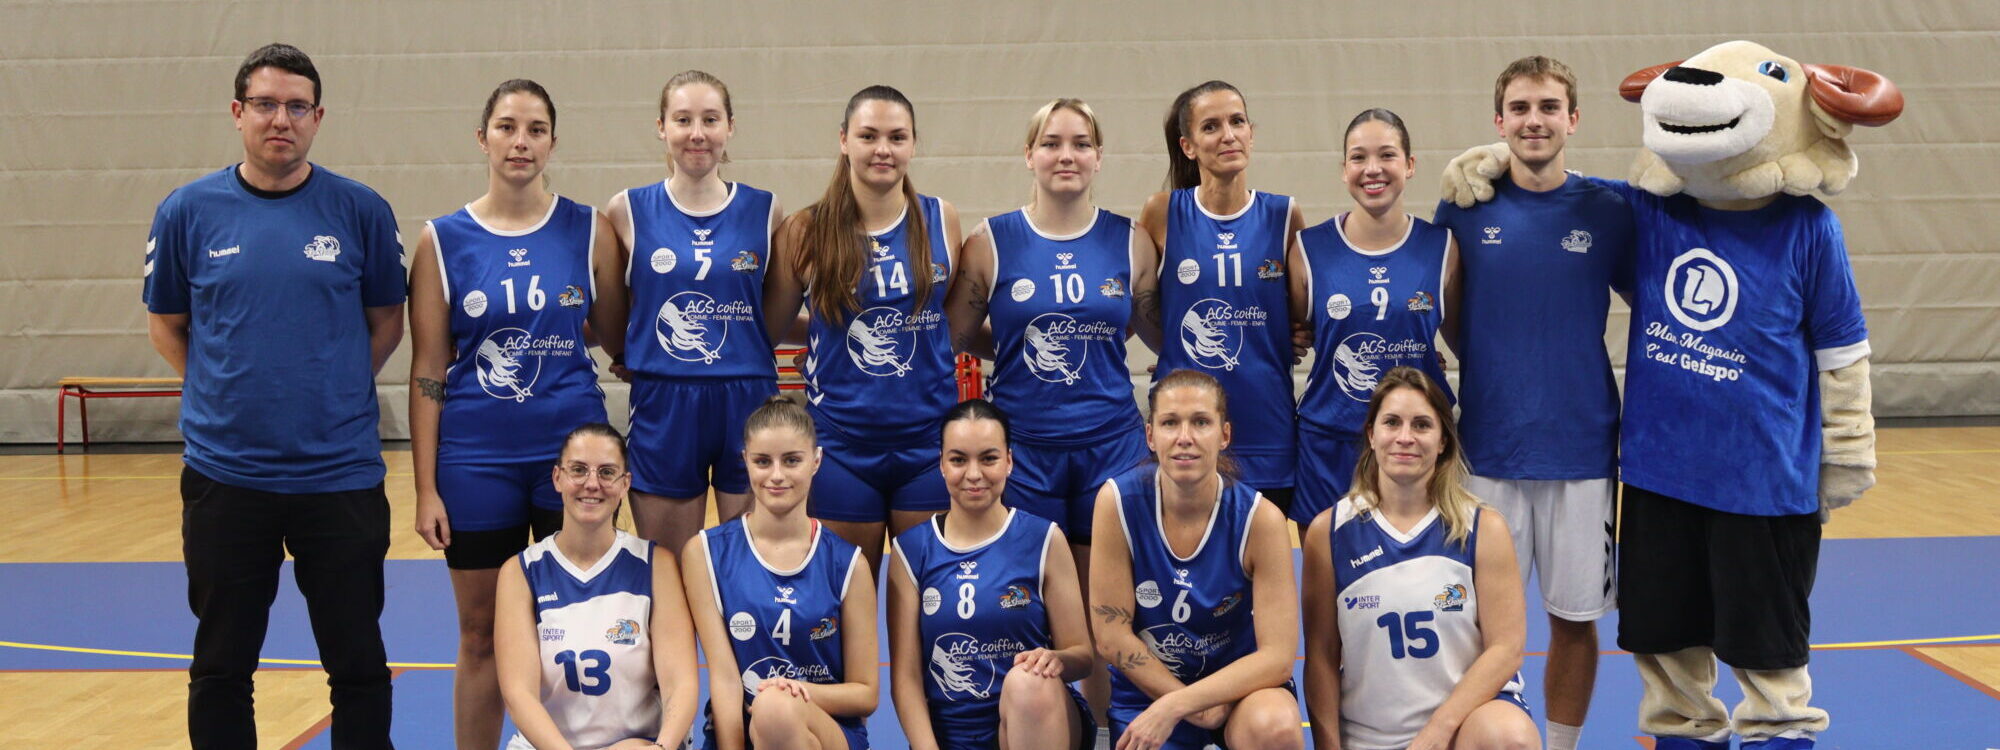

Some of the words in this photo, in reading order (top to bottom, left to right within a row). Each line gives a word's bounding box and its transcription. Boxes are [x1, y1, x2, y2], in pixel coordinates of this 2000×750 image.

[208, 245, 240, 259] hummel
[694, 248, 713, 281] 5
[1212, 252, 1243, 287] 11
[869, 261, 909, 298] 14
[1049, 273, 1085, 304] 10
[500, 275, 546, 314] 16
[1370, 286, 1389, 321] 9
[685, 300, 715, 314] ACS
[1206, 305, 1233, 320] ACS
[873, 312, 903, 328] ACS
[1048, 319, 1077, 335] ACS
[504, 335, 531, 350] ACS
[532, 334, 575, 350] coiffure
[1358, 339, 1387, 354] ACS
[1679, 332, 1747, 365] Magasin
[1350, 545, 1384, 569] hummel
[537, 592, 559, 604] mmel
[957, 583, 976, 620] 8
[1138, 594, 1159, 602] 2000
[1171, 589, 1192, 623] 6
[771, 608, 791, 646] 4
[1376, 610, 1440, 660] 15
[541, 634, 564, 642] SPORT
[949, 640, 979, 655] ACS
[1162, 632, 1193, 648] ACS
[554, 649, 612, 696] 13
[767, 665, 797, 679] ACS
